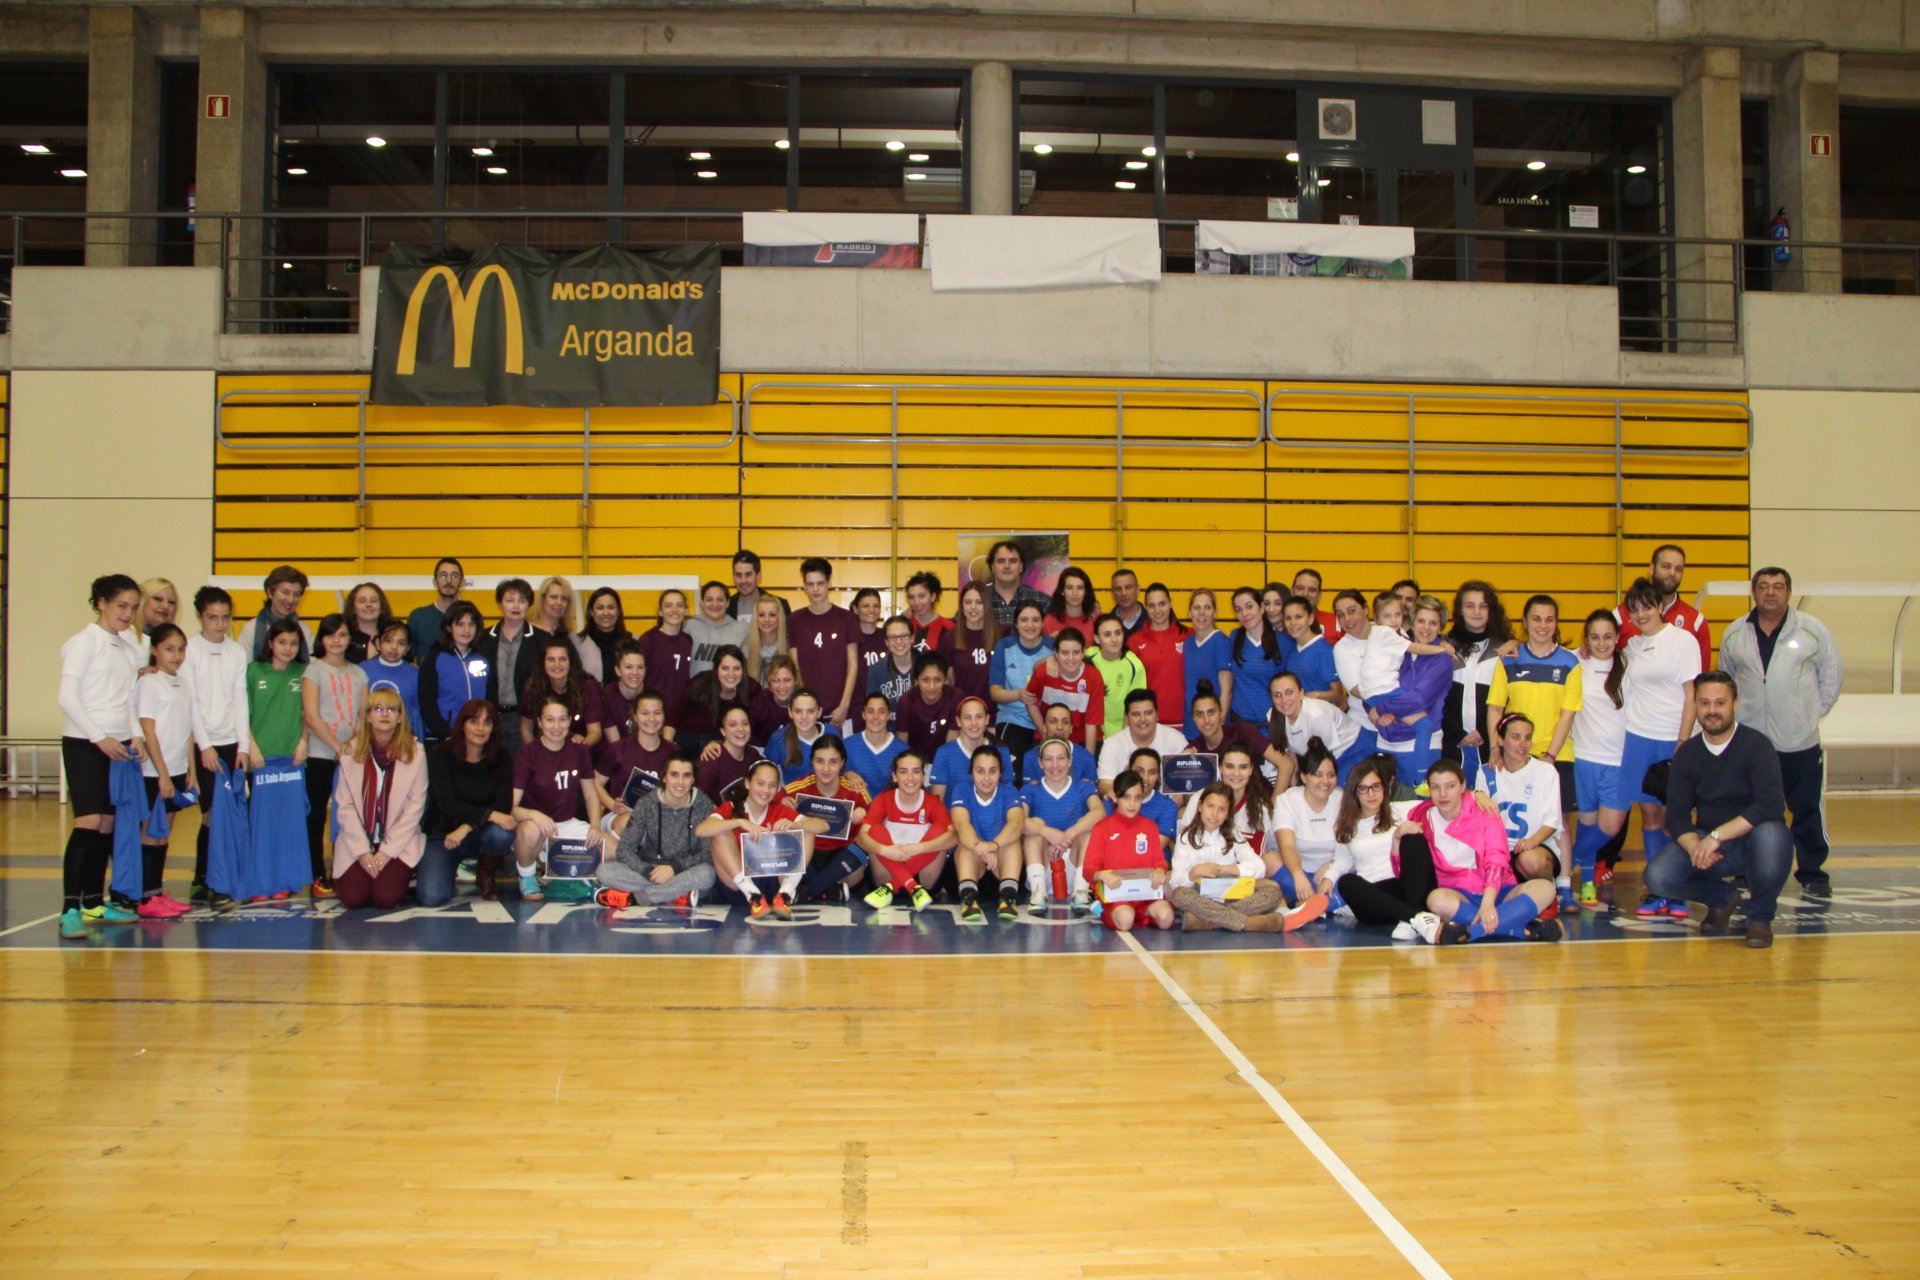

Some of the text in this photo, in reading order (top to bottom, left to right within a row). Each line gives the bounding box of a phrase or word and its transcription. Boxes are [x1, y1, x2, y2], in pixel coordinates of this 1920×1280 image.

[1498, 197, 1515, 205] SALA
[836, 243, 871, 251] MADRID
[551, 281, 704, 301] McDonald's
[559, 324, 694, 362] Arganda
[813, 632, 823, 648] 4
[673, 653, 682, 670] 7
[864, 651, 878, 666] 10
[971, 648, 988, 664] 18
[929, 721, 937, 733] 5
[554, 770, 569, 790] 17
[810, 802, 837, 812] DIPLOMA
[561, 844, 588, 852] DIPLOMA
[760, 860, 789, 869] DIPLOMA
